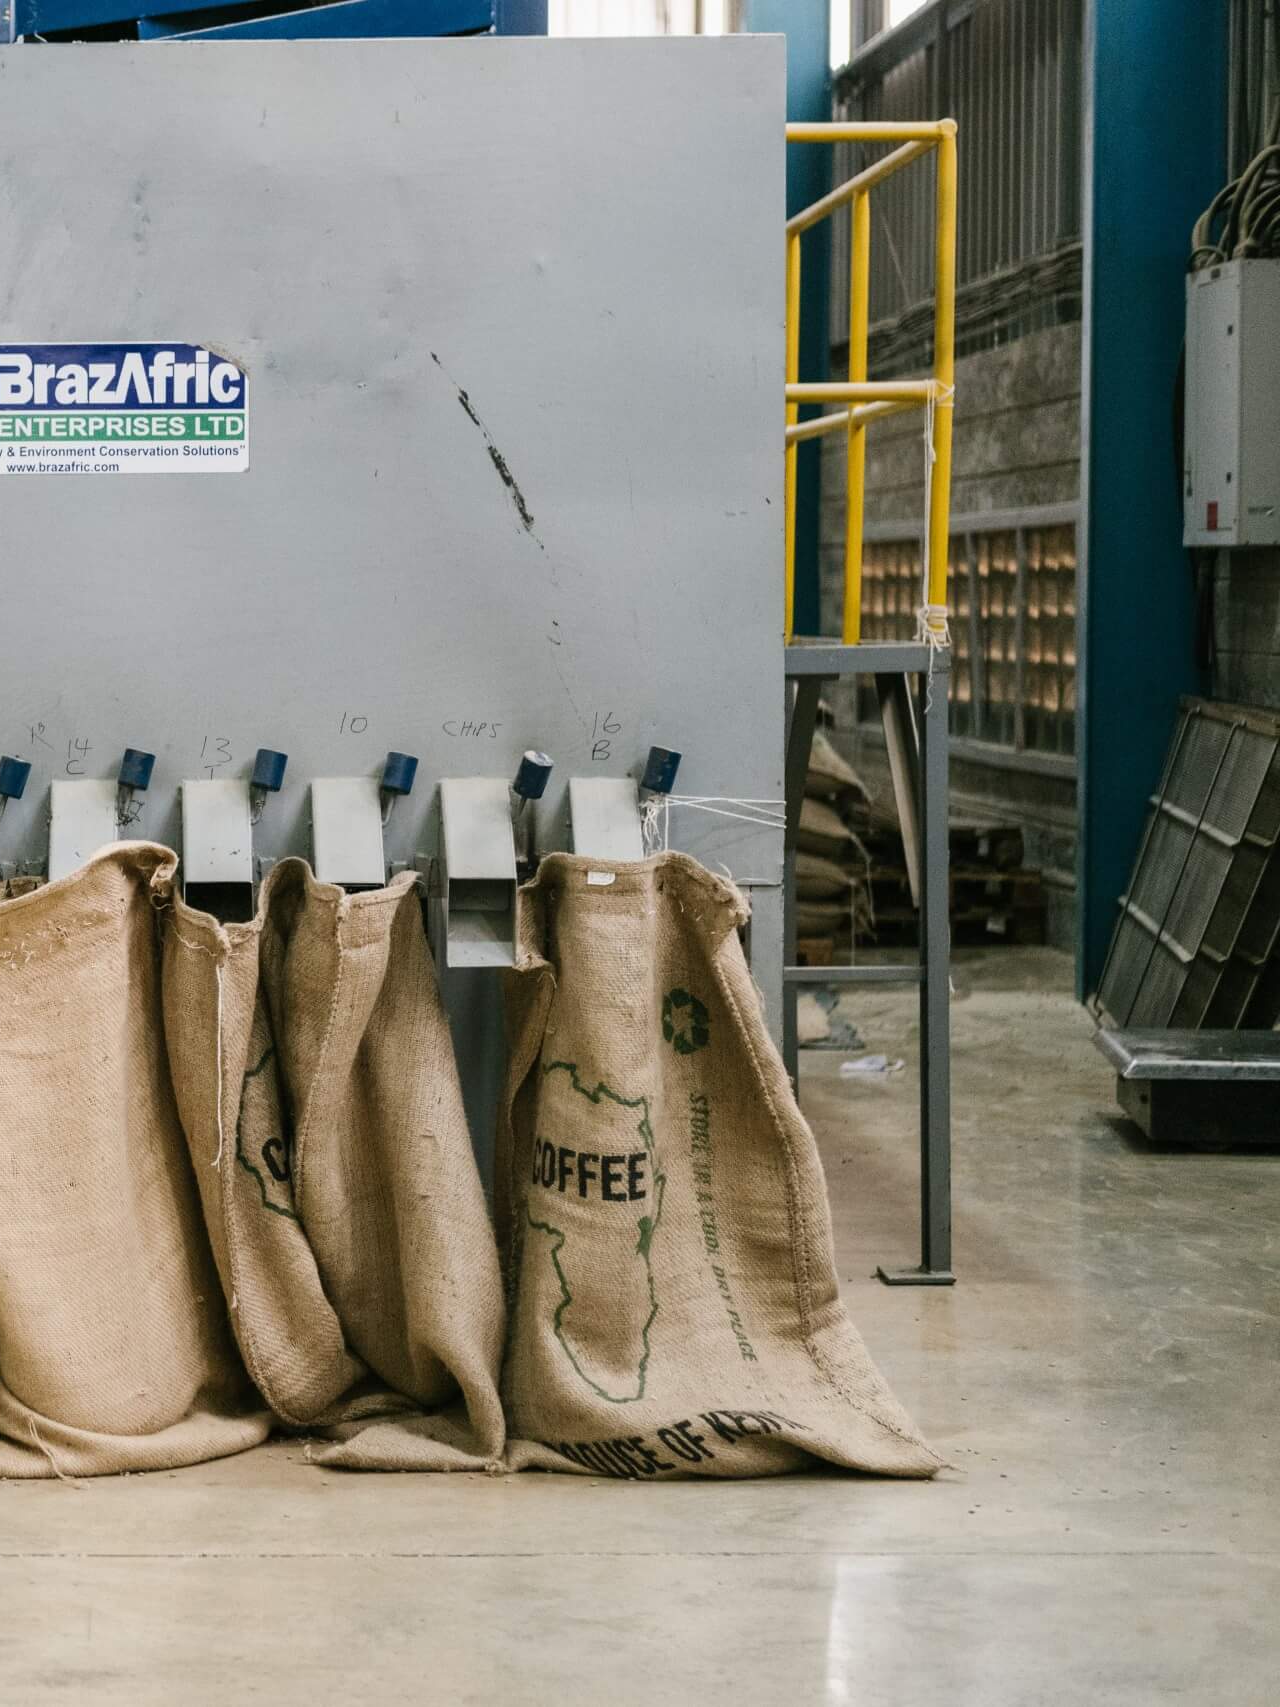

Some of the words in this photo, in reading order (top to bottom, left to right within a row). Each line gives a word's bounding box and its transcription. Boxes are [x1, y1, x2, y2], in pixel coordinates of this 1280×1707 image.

[194, 414, 243, 436] LTD
[6, 446, 15, 458] &
[19, 446, 96, 457] Environment
[99, 445, 179, 457] Conservation
[6, 461, 119, 474] www.brazafric.com
[340, 712, 368, 734] 10
[592, 712, 622, 738] 16
[67, 738, 95, 759] 14
[200, 736, 232, 763] 13
[592, 739, 610, 760] B
[66, 760, 85, 775] C
[533, 1138, 647, 1202] COFFEE
[726, 1308, 758, 1362] PLACE
[657, 1419, 715, 1462] OF
